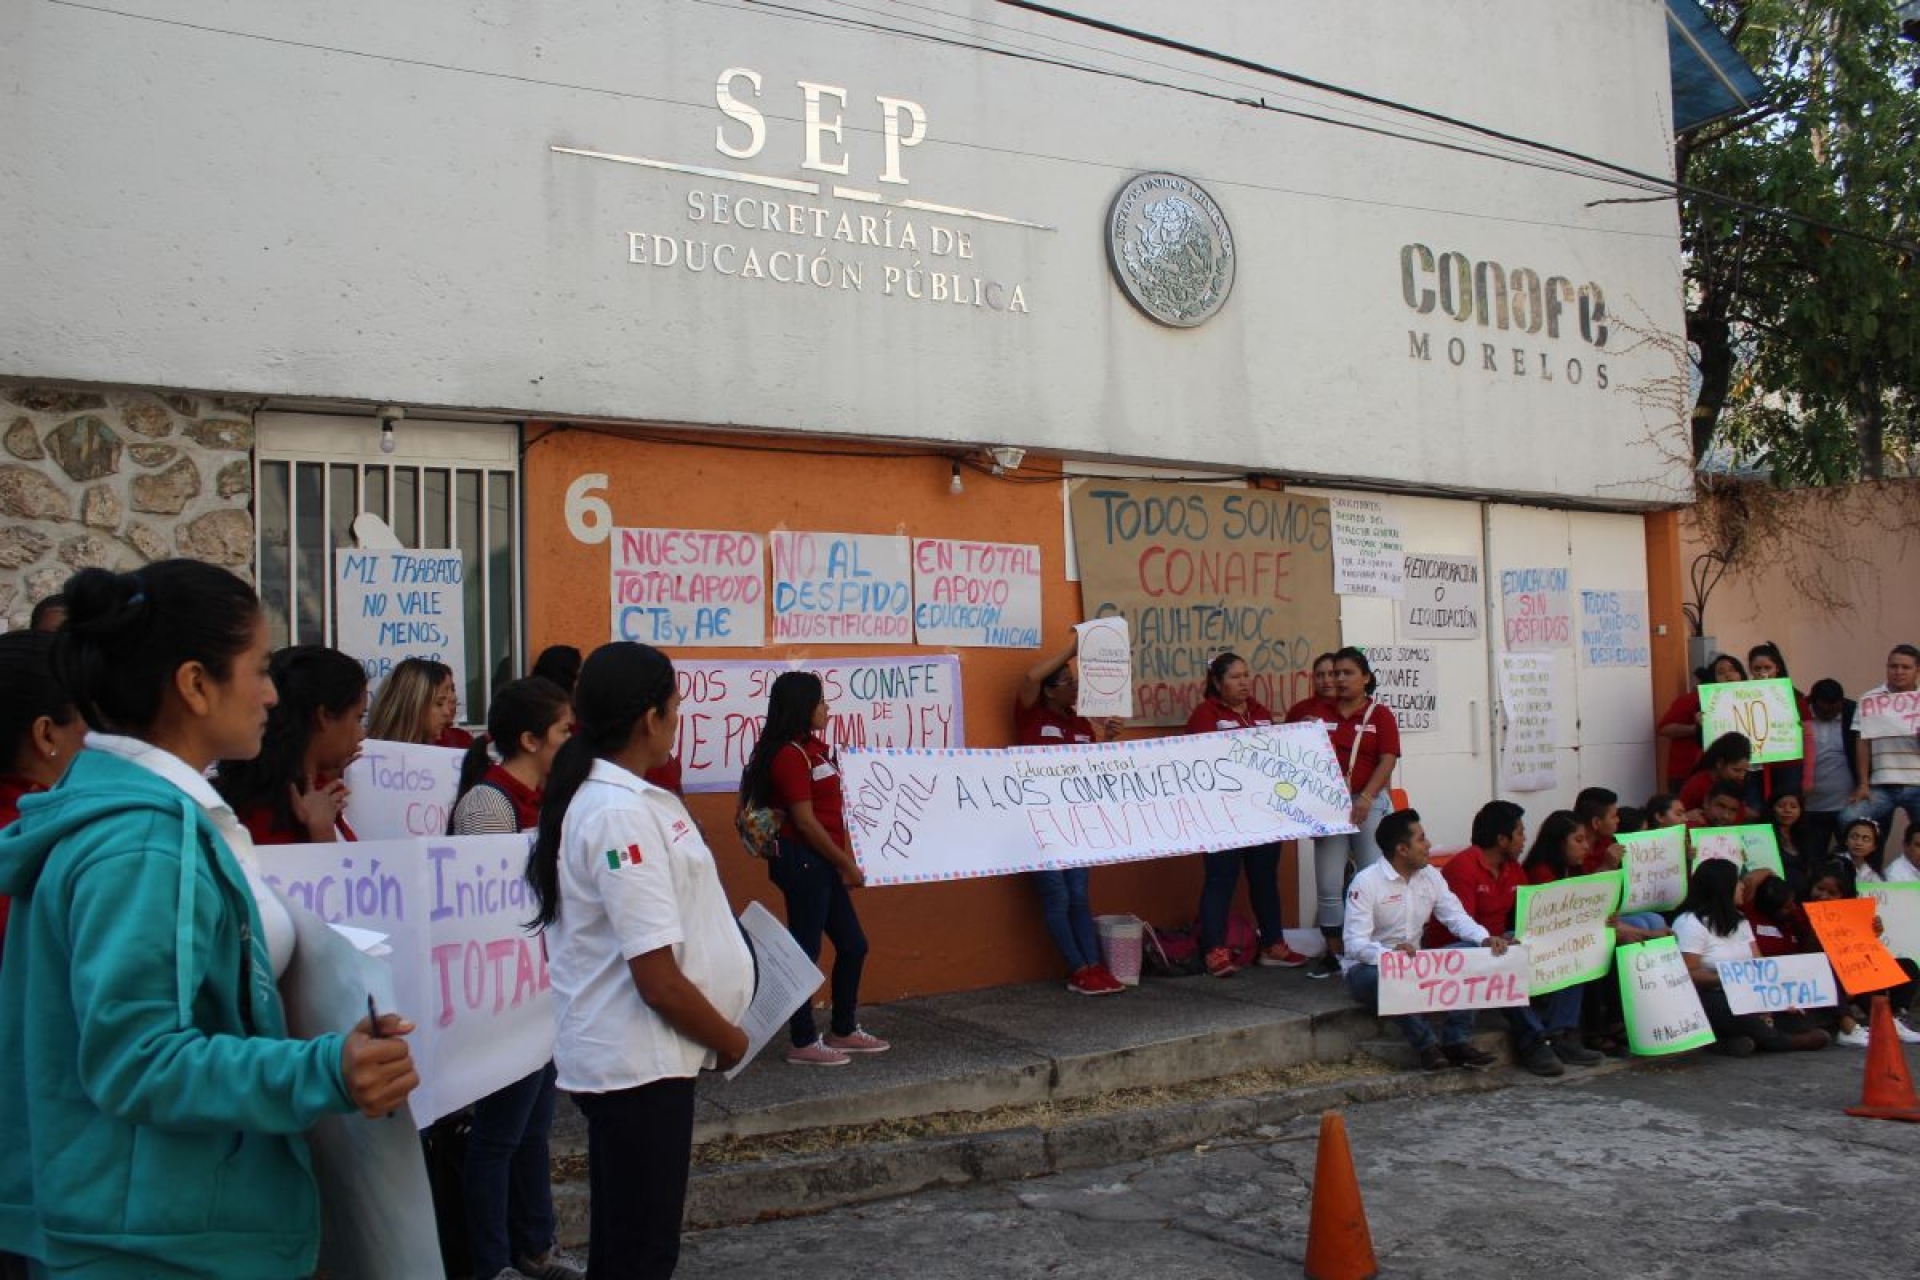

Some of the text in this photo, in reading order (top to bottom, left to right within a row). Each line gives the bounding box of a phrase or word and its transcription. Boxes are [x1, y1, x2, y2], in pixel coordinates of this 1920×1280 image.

[716, 67, 928, 185] SEP
[687, 190, 975, 259] SECRETARÍA DE
[626, 231, 1030, 314] EDUCACIÓN PÚBLICA
[1408, 330, 1610, 391] MORELOS
[564, 473, 613, 545] 6
[1089, 490, 1332, 552] TODOS SOMOS
[622, 530, 756, 566] NUESTRO
[775, 533, 871, 582] NO AL
[917, 540, 1040, 576] EN TOTAL
[343, 554, 463, 584] MI TRABAJO
[614, 569, 761, 604] TOTAL APOYO
[1138, 544, 1292, 602] CONAFE
[363, 591, 442, 617] NO VALE
[776, 580, 910, 615] DESPIDO
[933, 575, 1009, 607] APOYO
[1519, 594, 1547, 616] SIN
[378, 621, 449, 647] MENOS,
[695, 607, 732, 639] AE
[773, 612, 908, 638] INJUSTIFICADO
[985, 626, 1042, 647] INICIAL
[1506, 615, 1569, 643] DESPIDOS
[678, 669, 727, 703] DOS
[850, 664, 939, 700] CONAFE
[872, 702, 894, 721] DE
[1732, 700, 1768, 741] NO
[362, 754, 436, 792] Todos
[852, 761, 894, 837] APOYO
[956, 774, 979, 810] A
[982, 774, 1051, 811] LOS
[881, 773, 938, 859] TOTAL
[431, 934, 551, 1030] TOTAL
[1381, 949, 1465, 980] APOYO
[1721, 959, 1779, 985] APOYO
[1418, 973, 1526, 1007] TOTAL
[1753, 978, 1828, 1009] TOTAL
